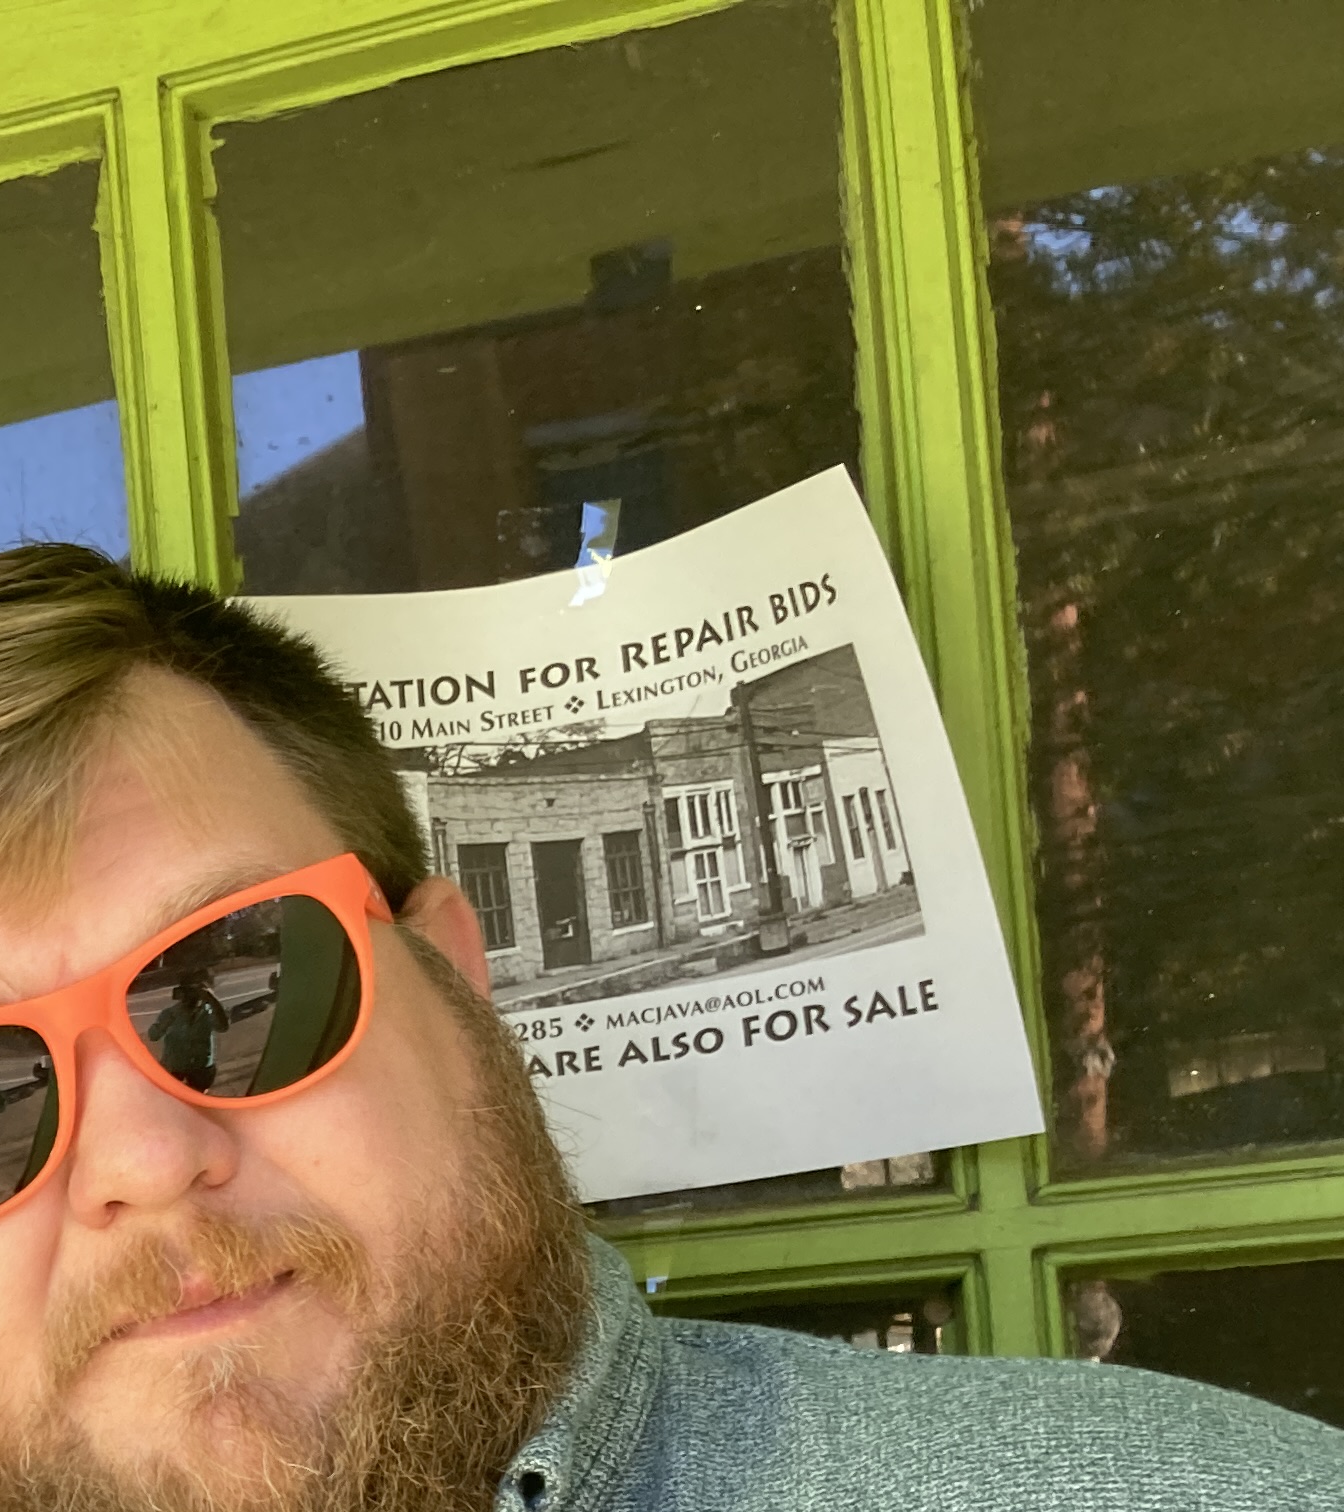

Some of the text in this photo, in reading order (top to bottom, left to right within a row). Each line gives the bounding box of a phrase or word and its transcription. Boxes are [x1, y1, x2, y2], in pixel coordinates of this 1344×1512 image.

[520, 656, 601, 694] FOR
[620, 604, 760, 674] REPAIR
[769, 572, 838, 626] BIDS
[379, 720, 402, 741] 10
[514, 1016, 563, 1042] 285
[528, 979, 940, 1080] ARE ALSO FOR SALE
